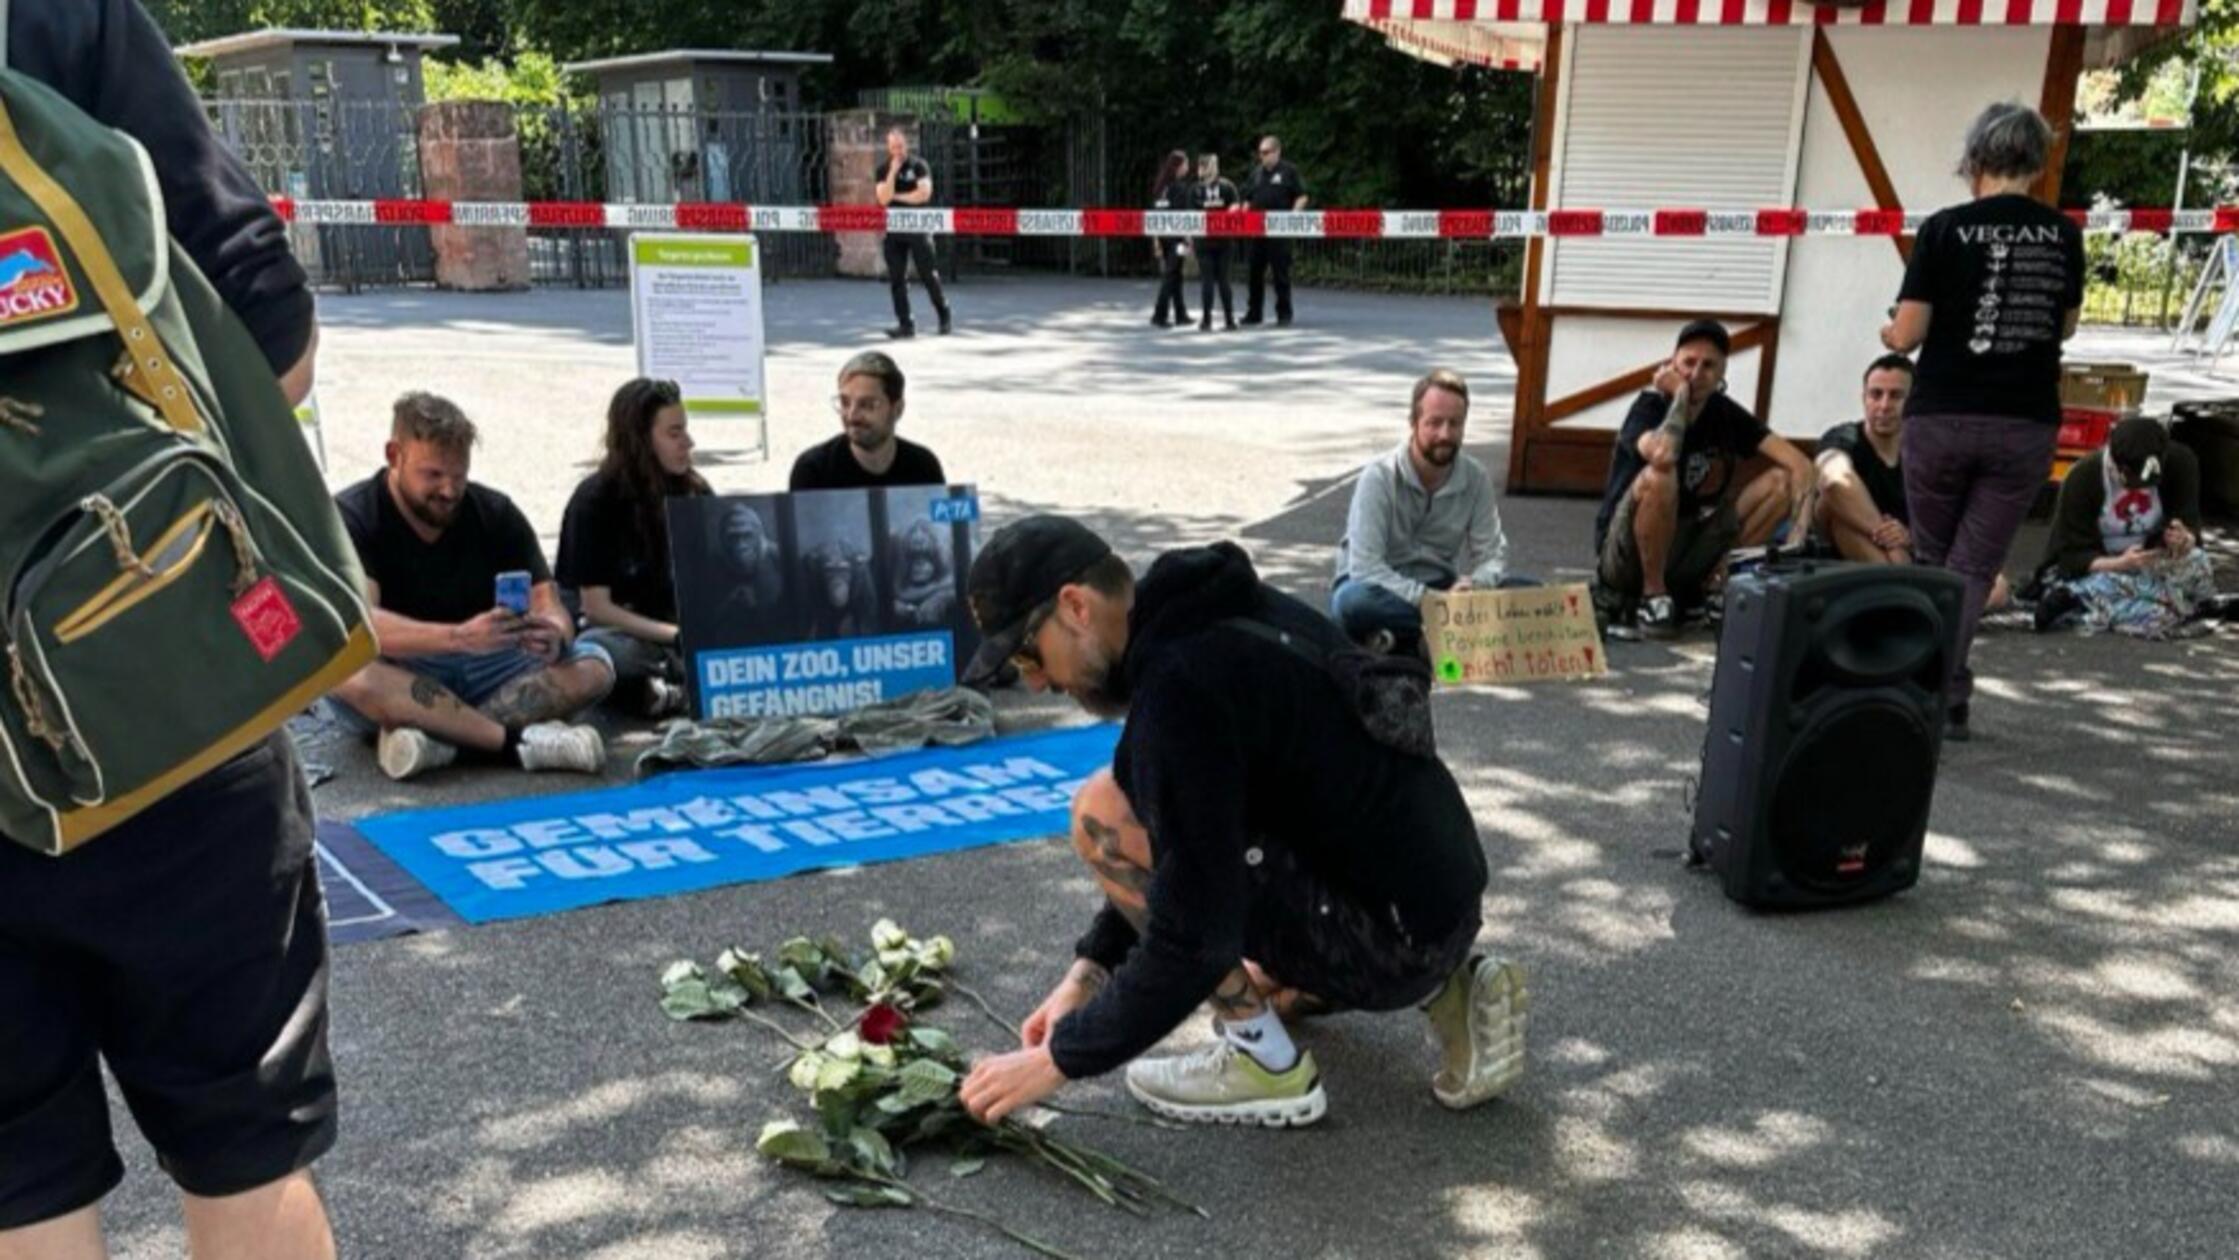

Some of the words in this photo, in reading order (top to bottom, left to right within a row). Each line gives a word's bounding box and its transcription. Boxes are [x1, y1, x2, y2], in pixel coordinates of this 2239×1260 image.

[706, 652, 778, 687] DEIN
[783, 647, 849, 680] ZOO,
[853, 640, 947, 671] UNSER
[1462, 649, 1515, 679] nicht
[710, 679, 884, 718] GEFÄNGNIS!
[431, 756, 1067, 858] GEMEINSAM
